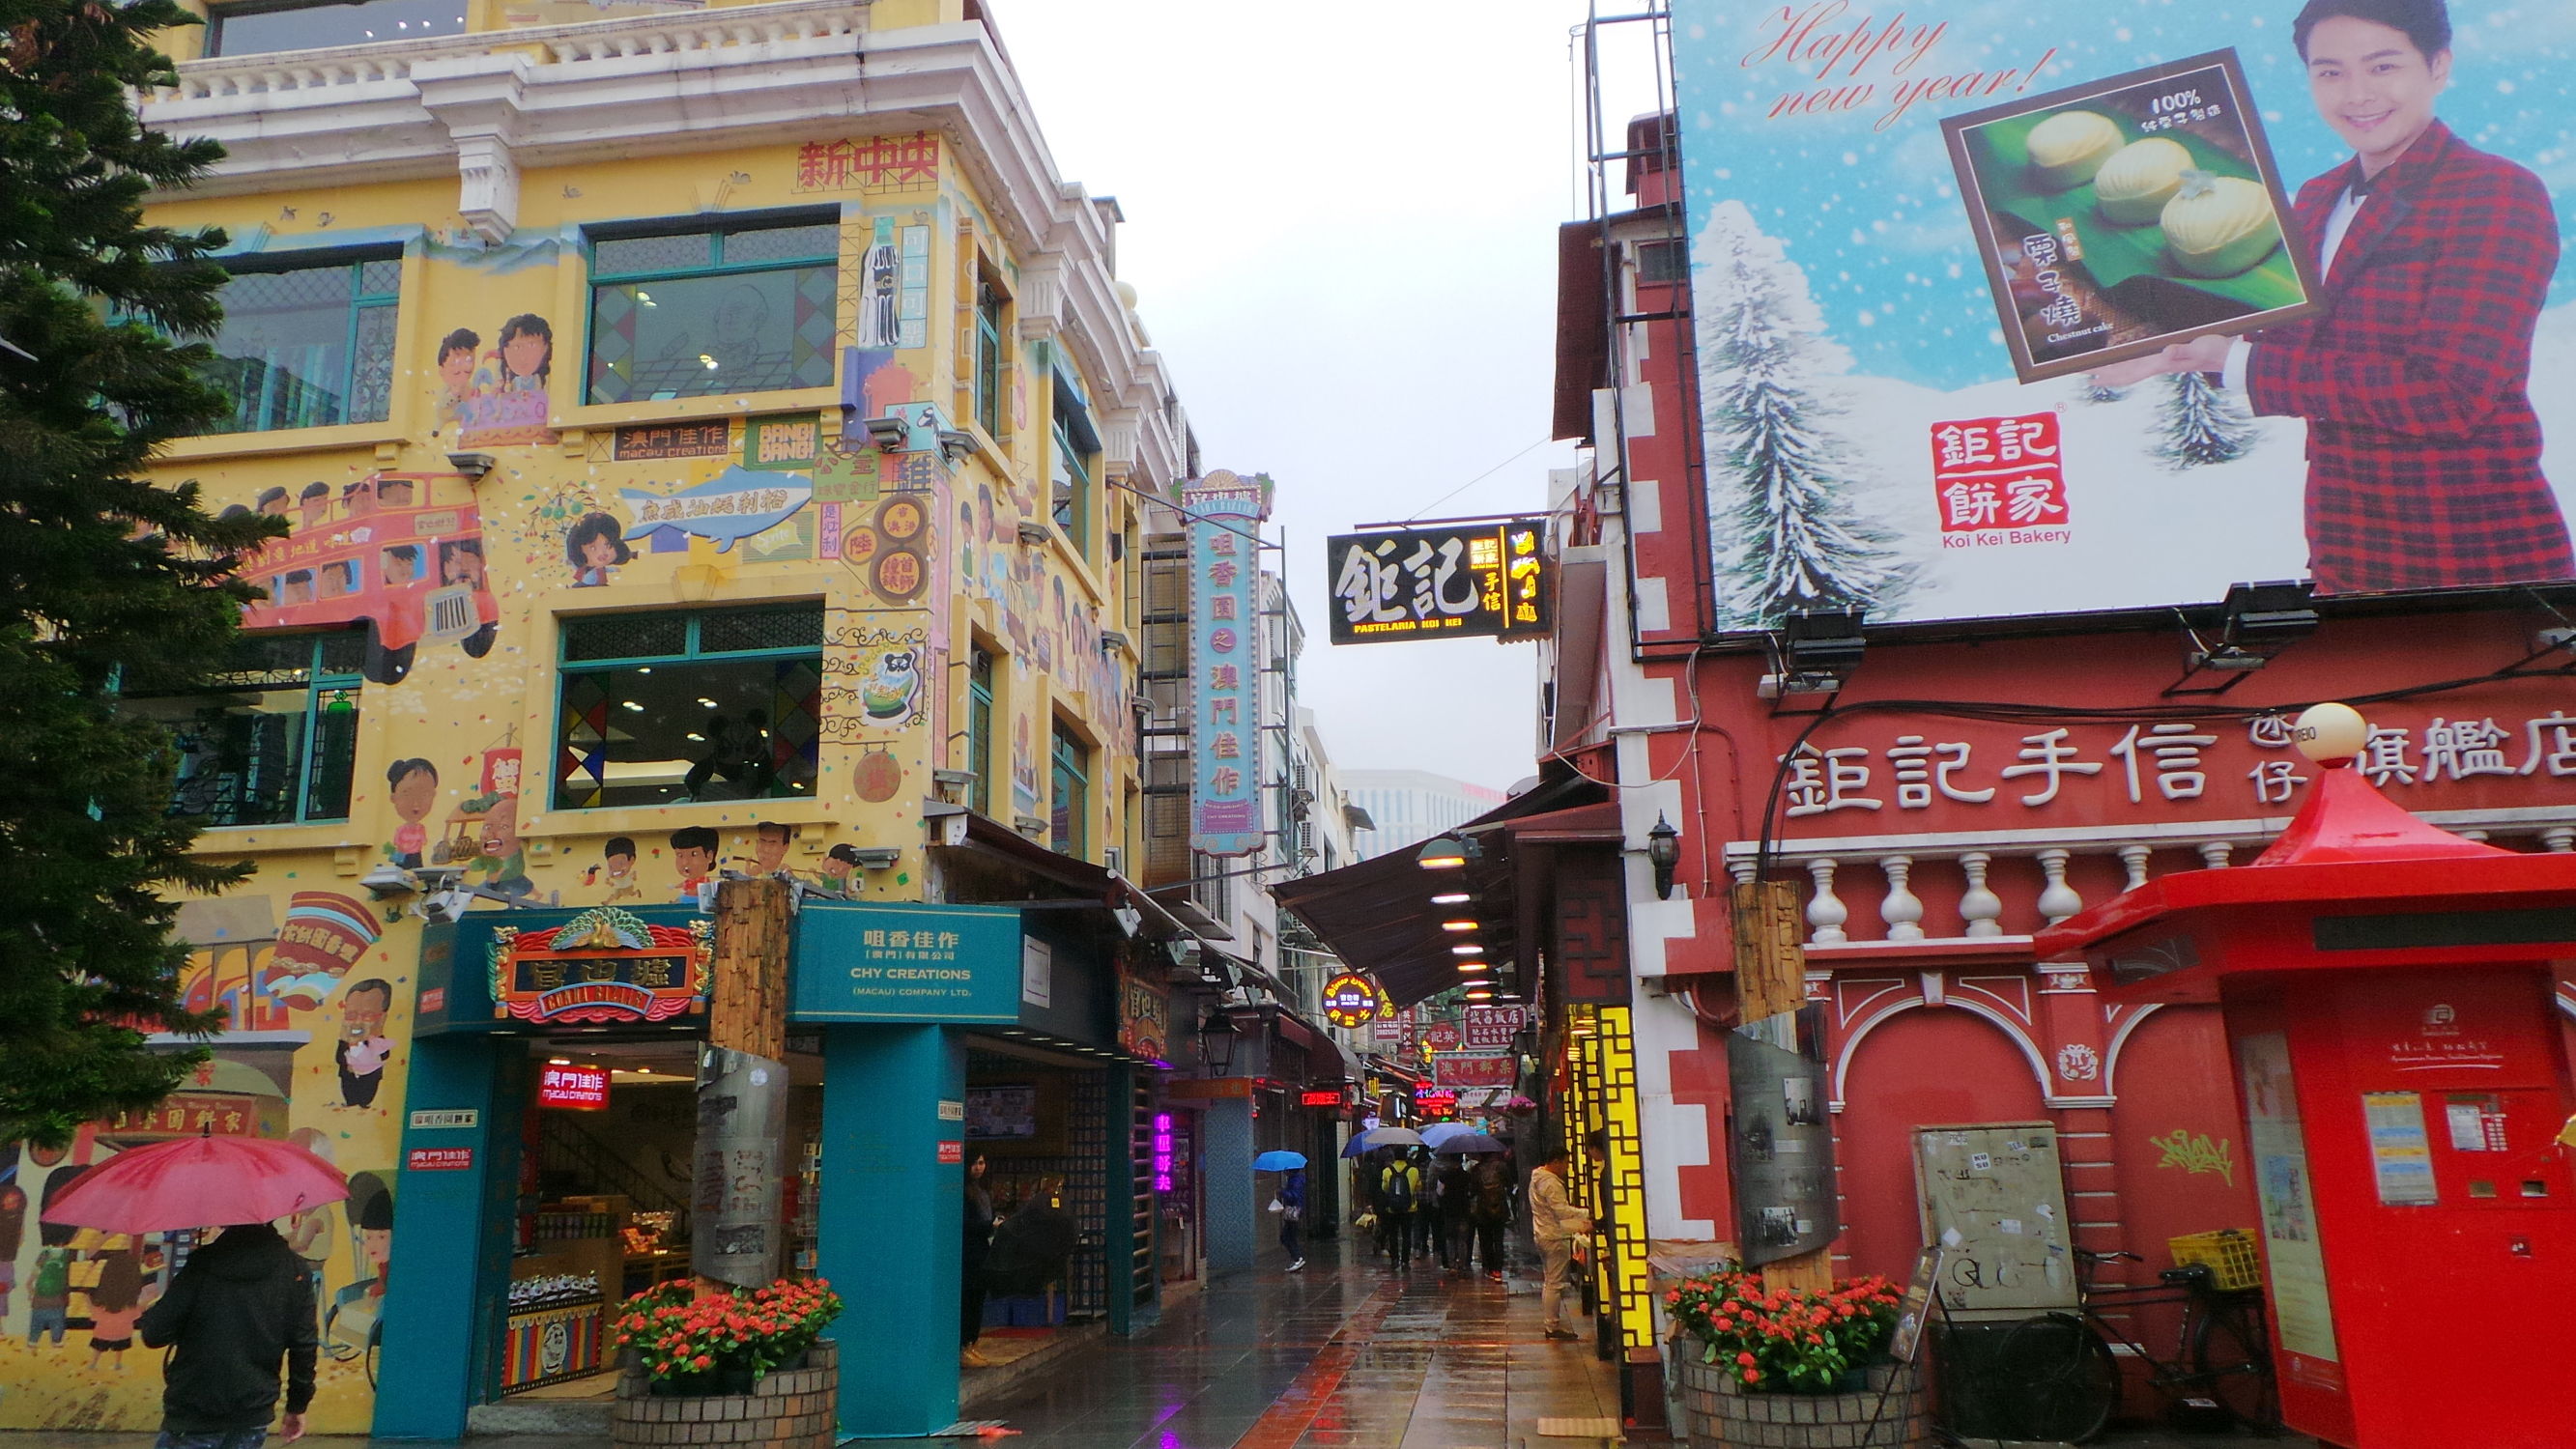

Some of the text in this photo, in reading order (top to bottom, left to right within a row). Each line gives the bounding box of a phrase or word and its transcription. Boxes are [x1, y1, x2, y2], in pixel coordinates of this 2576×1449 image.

[1741, 0, 1948, 80] Happy
[1767, 47, 2059, 132] new year!
[2152, 89, 2202, 114] 100%
[799, 130, 939, 187] 新中央
[2023, 232, 2082, 327] 栗子燒
[2046, 320, 2115, 344] Chestnut cake
[623, 425, 725, 448] 澳門佳作
[1937, 419, 2058, 469] 鉅記
[1943, 475, 2064, 526] 餅家
[1943, 528, 2072, 549] Koi Kei Bakery
[1334, 536, 1479, 623] 鉅記
[1483, 571, 1501, 611] 手信
[1354, 617, 1462, 634] PASTELARIA KOI KEI
[1209, 531, 1241, 798] 咀香園之澳門佳作
[2346, 710, 2576, 788] 旗艦店
[1777, 724, 2219, 818] 鉅記手信
[864, 929, 959, 949] 咀香佳作
[532, 957, 673, 988] 官也墟
[850, 967, 971, 980] CHY CREATIONS
[852, 987, 972, 997] (MACAU) COMPANY LTD.
[544, 1068, 604, 1091] 澳門佳作
